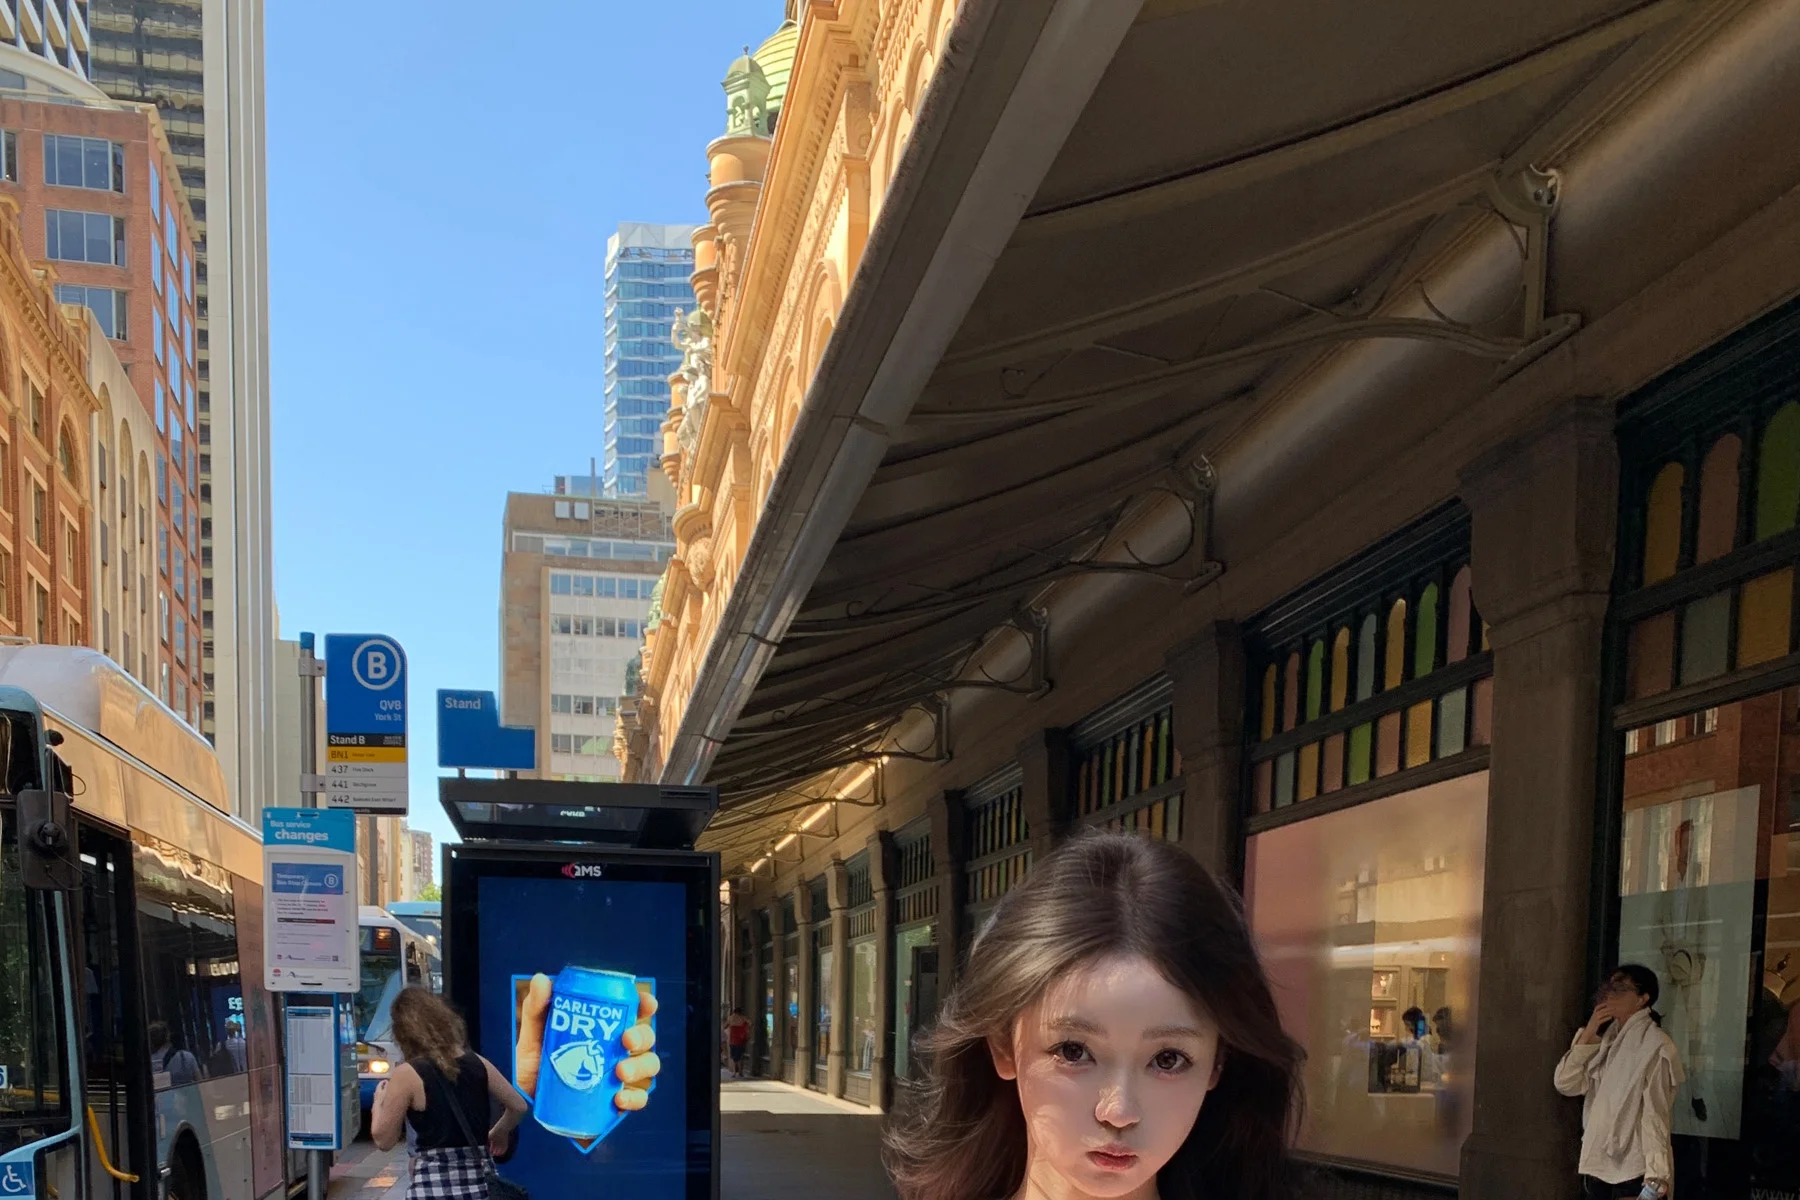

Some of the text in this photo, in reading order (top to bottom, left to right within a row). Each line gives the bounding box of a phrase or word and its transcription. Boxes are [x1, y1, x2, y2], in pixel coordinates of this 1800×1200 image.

[367, 651, 387, 679] B
[379, 700, 402, 711] QVB
[445, 697, 481, 710] Stand
[374, 713, 392, 721] York
[330, 735, 366, 745] Stand B
[331, 765, 348, 773] 437
[331, 795, 350, 803] 442
[270, 820, 312, 829] Bus service
[275, 829, 329, 843] changes
[554, 996, 622, 1020] CARLTON
[551, 1008, 620, 1041] DRY
